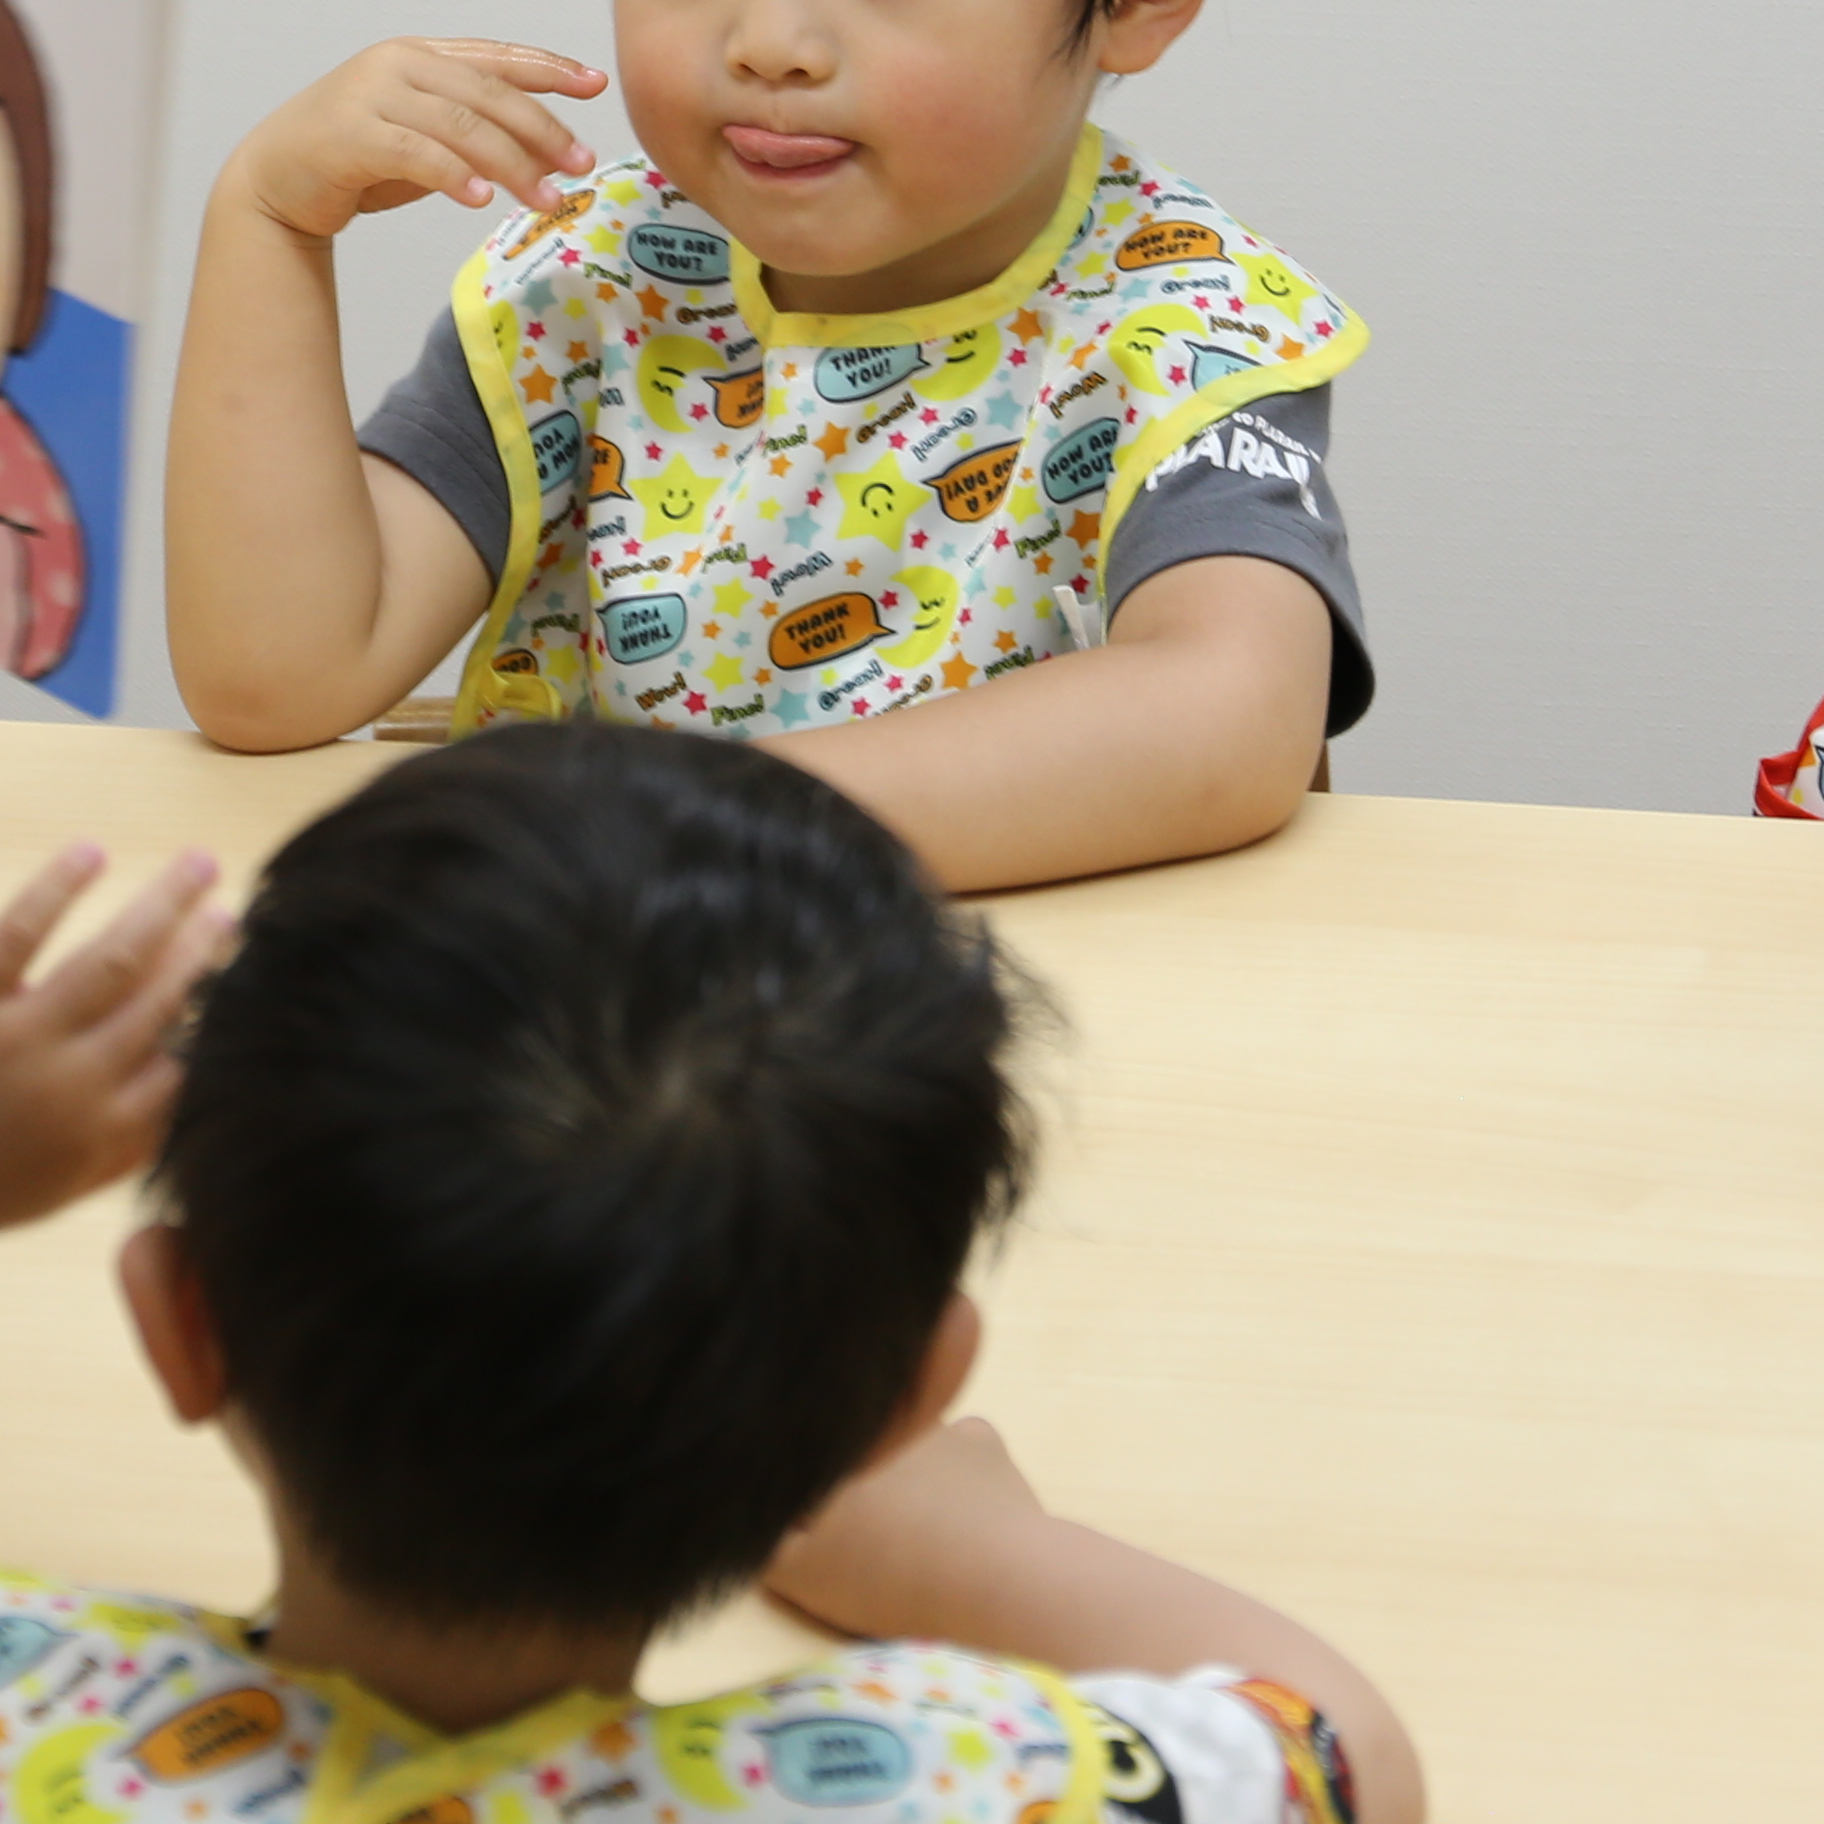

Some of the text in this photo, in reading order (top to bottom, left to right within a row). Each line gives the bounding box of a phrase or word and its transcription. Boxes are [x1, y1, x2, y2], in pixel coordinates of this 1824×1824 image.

[635, 231, 719, 256] HOW ARE
[1125, 231, 1166, 253] HOW
[654, 251, 704, 272] YOU?
[845, 359, 892, 389] YOU!
[1048, 371, 1108, 419] Wow!
[1047, 446, 1086, 481] HOW
[945, 470, 988, 501] DAY!
[769, 551, 834, 597] Wow!
[621, 605, 662, 632] YOU!
[782, 601, 852, 641] THANK
[619, 622, 674, 654] THANK
[798, 624, 848, 655] YOU!
[634, 671, 688, 713] Wow!
[711, 693, 766, 727] Fine!
